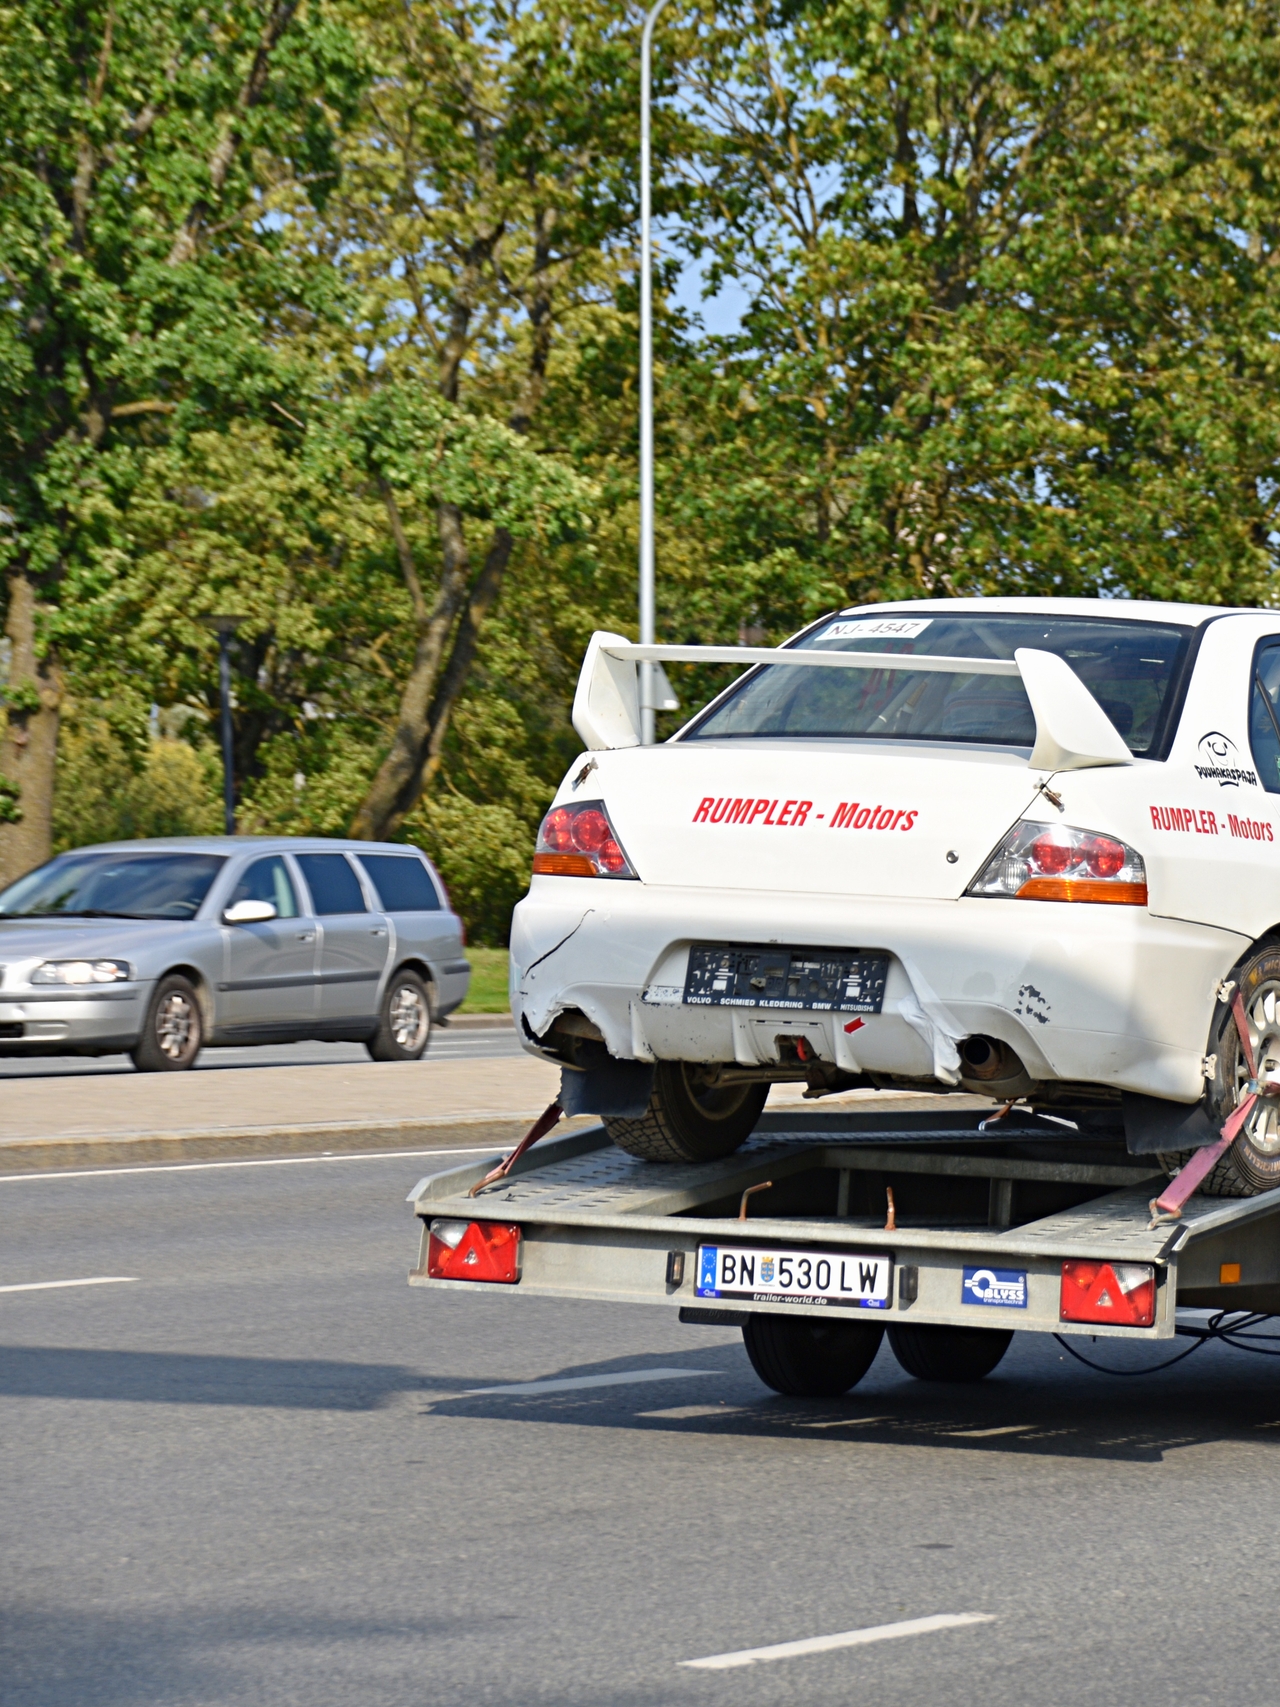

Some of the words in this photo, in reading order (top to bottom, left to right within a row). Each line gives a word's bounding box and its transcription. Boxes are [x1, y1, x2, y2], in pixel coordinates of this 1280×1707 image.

[692, 797, 813, 826] RUMPLER
[829, 802, 918, 831] Motors
[1149, 805, 1218, 835] RUMPLER
[1227, 813, 1274, 842] Motors
[687, 997, 712, 1005] VOLVO
[720, 998, 756, 1007] SCHMIED
[759, 1000, 803, 1009] KLEDERING
[812, 1002, 831, 1010] BMW
[840, 1004, 874, 1012] MITSUBISHI
[704, 1272, 712, 1283] A
[721, 1254, 755, 1286] BN
[778, 1257, 831, 1291] 530
[840, 1260, 878, 1293] LW
[753, 1293, 827, 1305] trailer-world.de
[984, 1288, 1024, 1301] BLYSS
